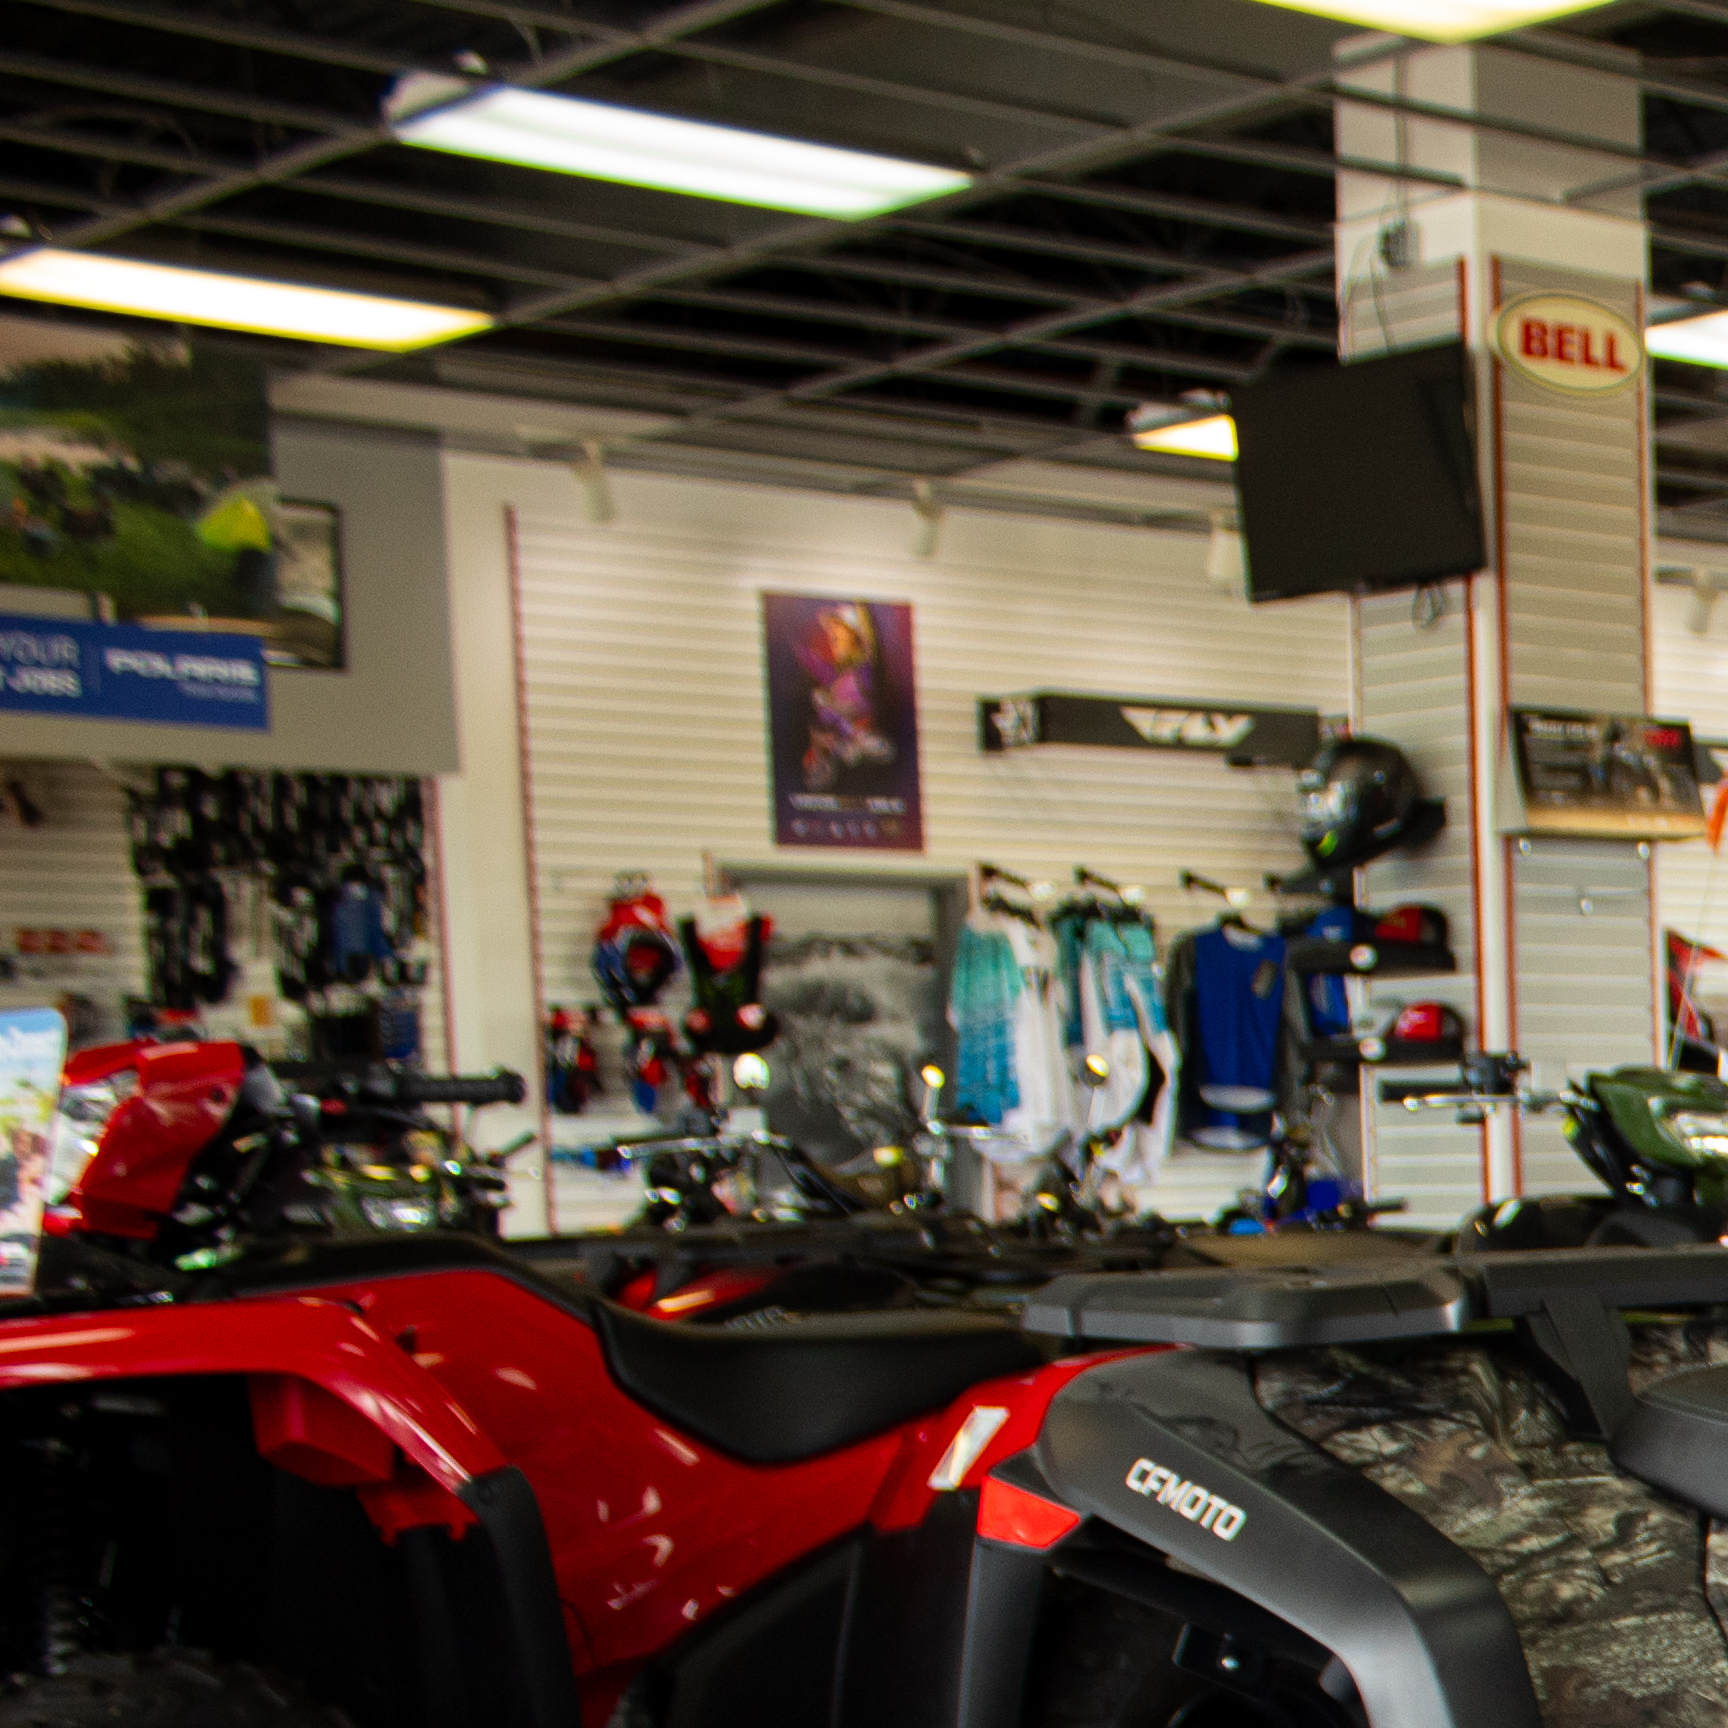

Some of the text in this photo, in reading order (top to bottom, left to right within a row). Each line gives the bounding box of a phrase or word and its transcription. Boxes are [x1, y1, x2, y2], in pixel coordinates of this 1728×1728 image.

[1518, 317, 1628, 374] BELL
[105, 649, 261, 687] POLARIS
[1125, 1457, 1248, 1543] CFMOTO
